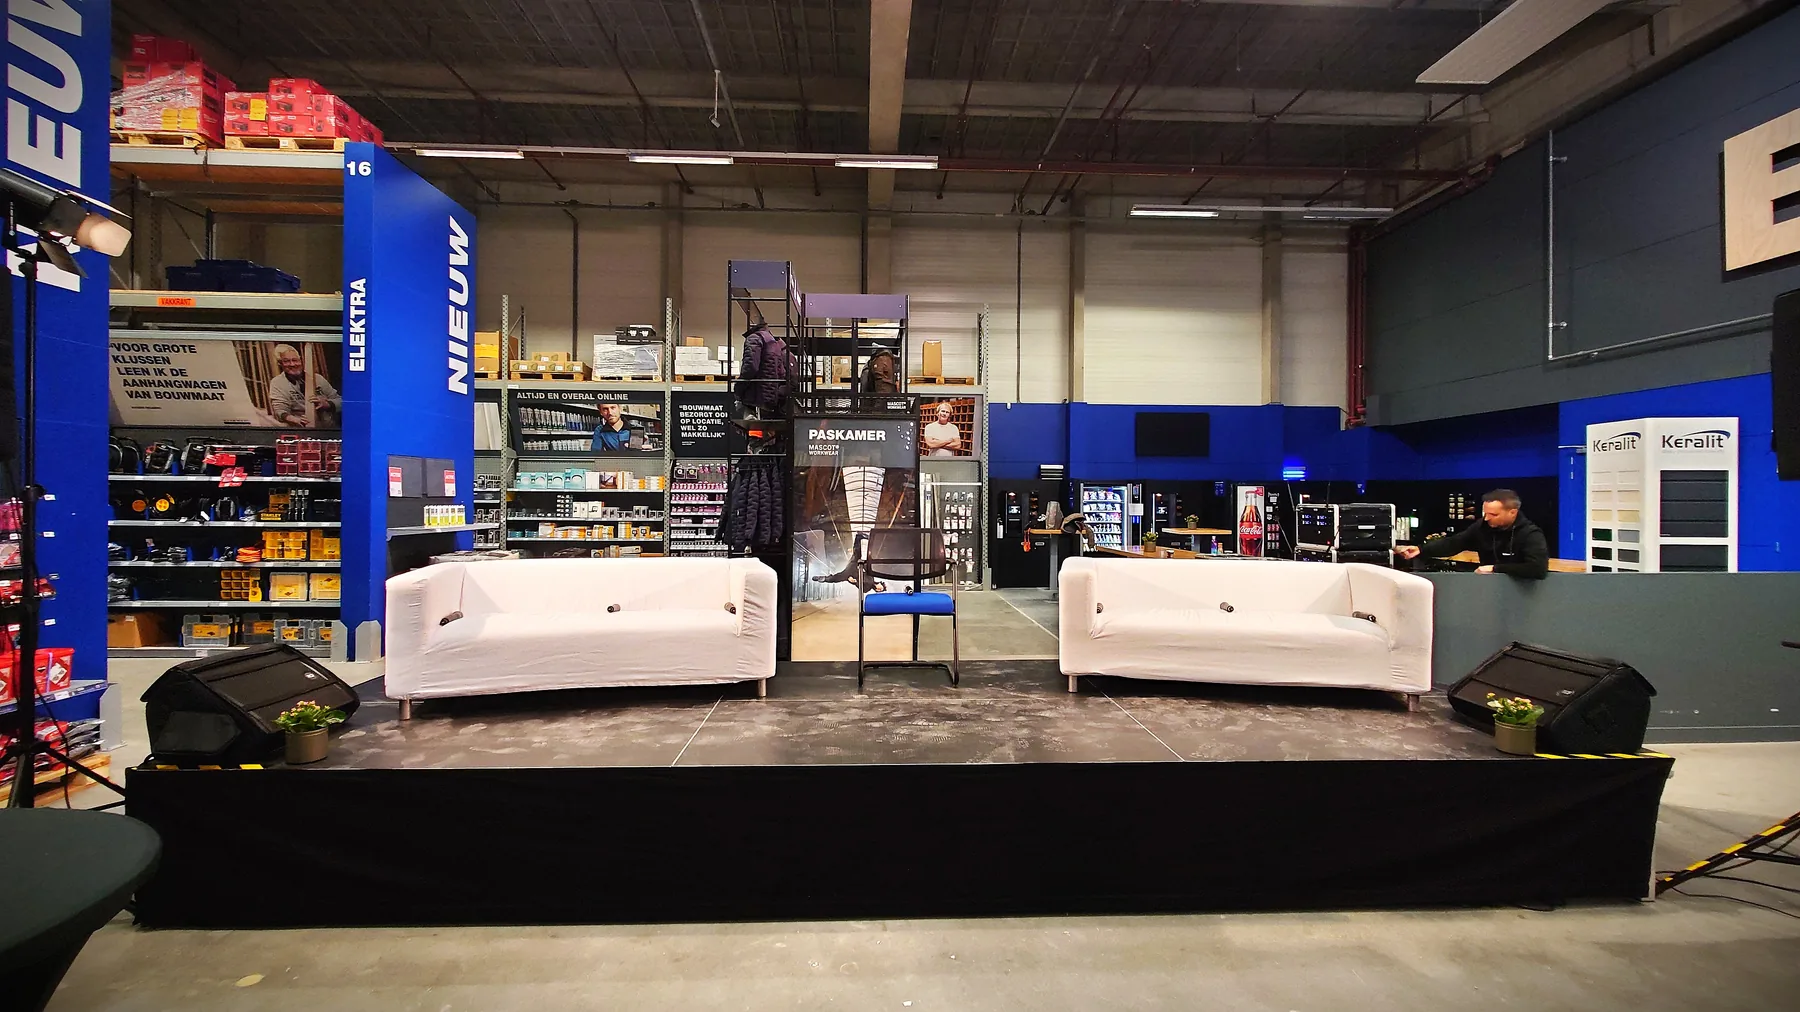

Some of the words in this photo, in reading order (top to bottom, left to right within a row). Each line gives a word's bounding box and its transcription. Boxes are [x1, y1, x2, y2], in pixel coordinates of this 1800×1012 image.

[347, 161, 371, 176] 16
[448, 215, 470, 394] NIEUW
[349, 278, 366, 372] ELEKTRA
[153, 344, 197, 354] GROTE
[112, 355, 171, 365] KLUSSEN
[117, 367, 151, 376] LEEN
[153, 368, 167, 377] IK
[170, 368, 188, 377] DE
[123, 379, 227, 390] AANHANGWAGEN
[125, 390, 152, 400] VAN
[154, 391, 225, 401] BOUWMAAT
[808, 430, 886, 440] PASKAMER
[1593, 437, 1637, 452] Keralit
[1662, 434, 1724, 449] Keralit
